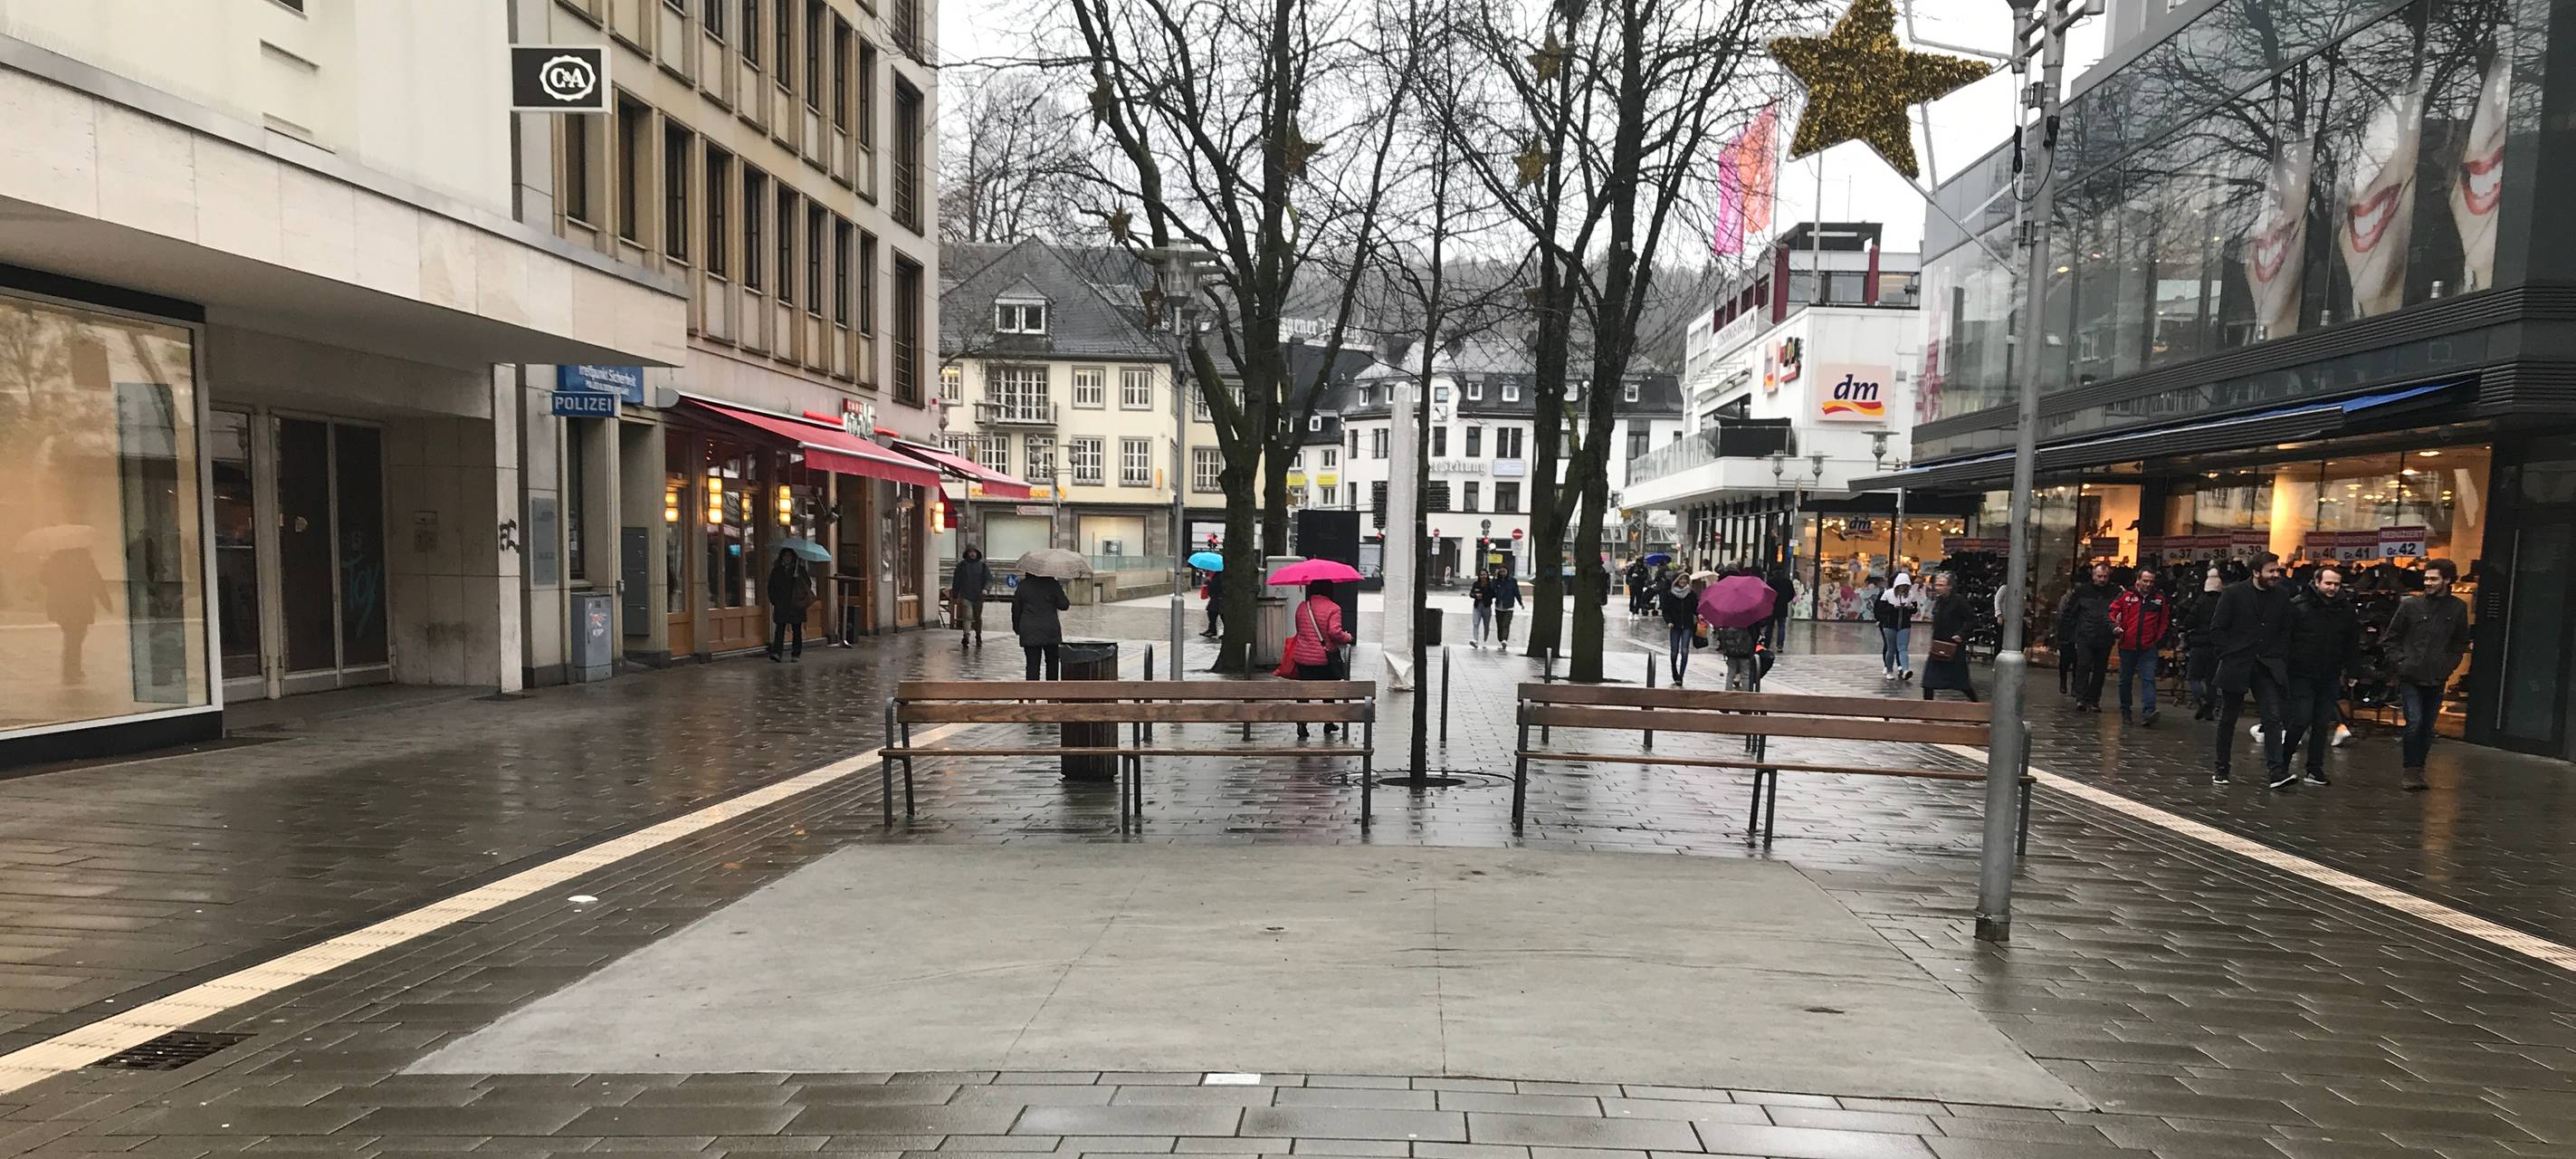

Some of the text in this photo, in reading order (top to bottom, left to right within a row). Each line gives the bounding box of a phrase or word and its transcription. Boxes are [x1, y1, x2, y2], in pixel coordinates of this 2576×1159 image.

[549, 68, 587, 88] C&A
[1834, 374, 1878, 400] dm
[555, 397, 612, 411] POLIZEI
